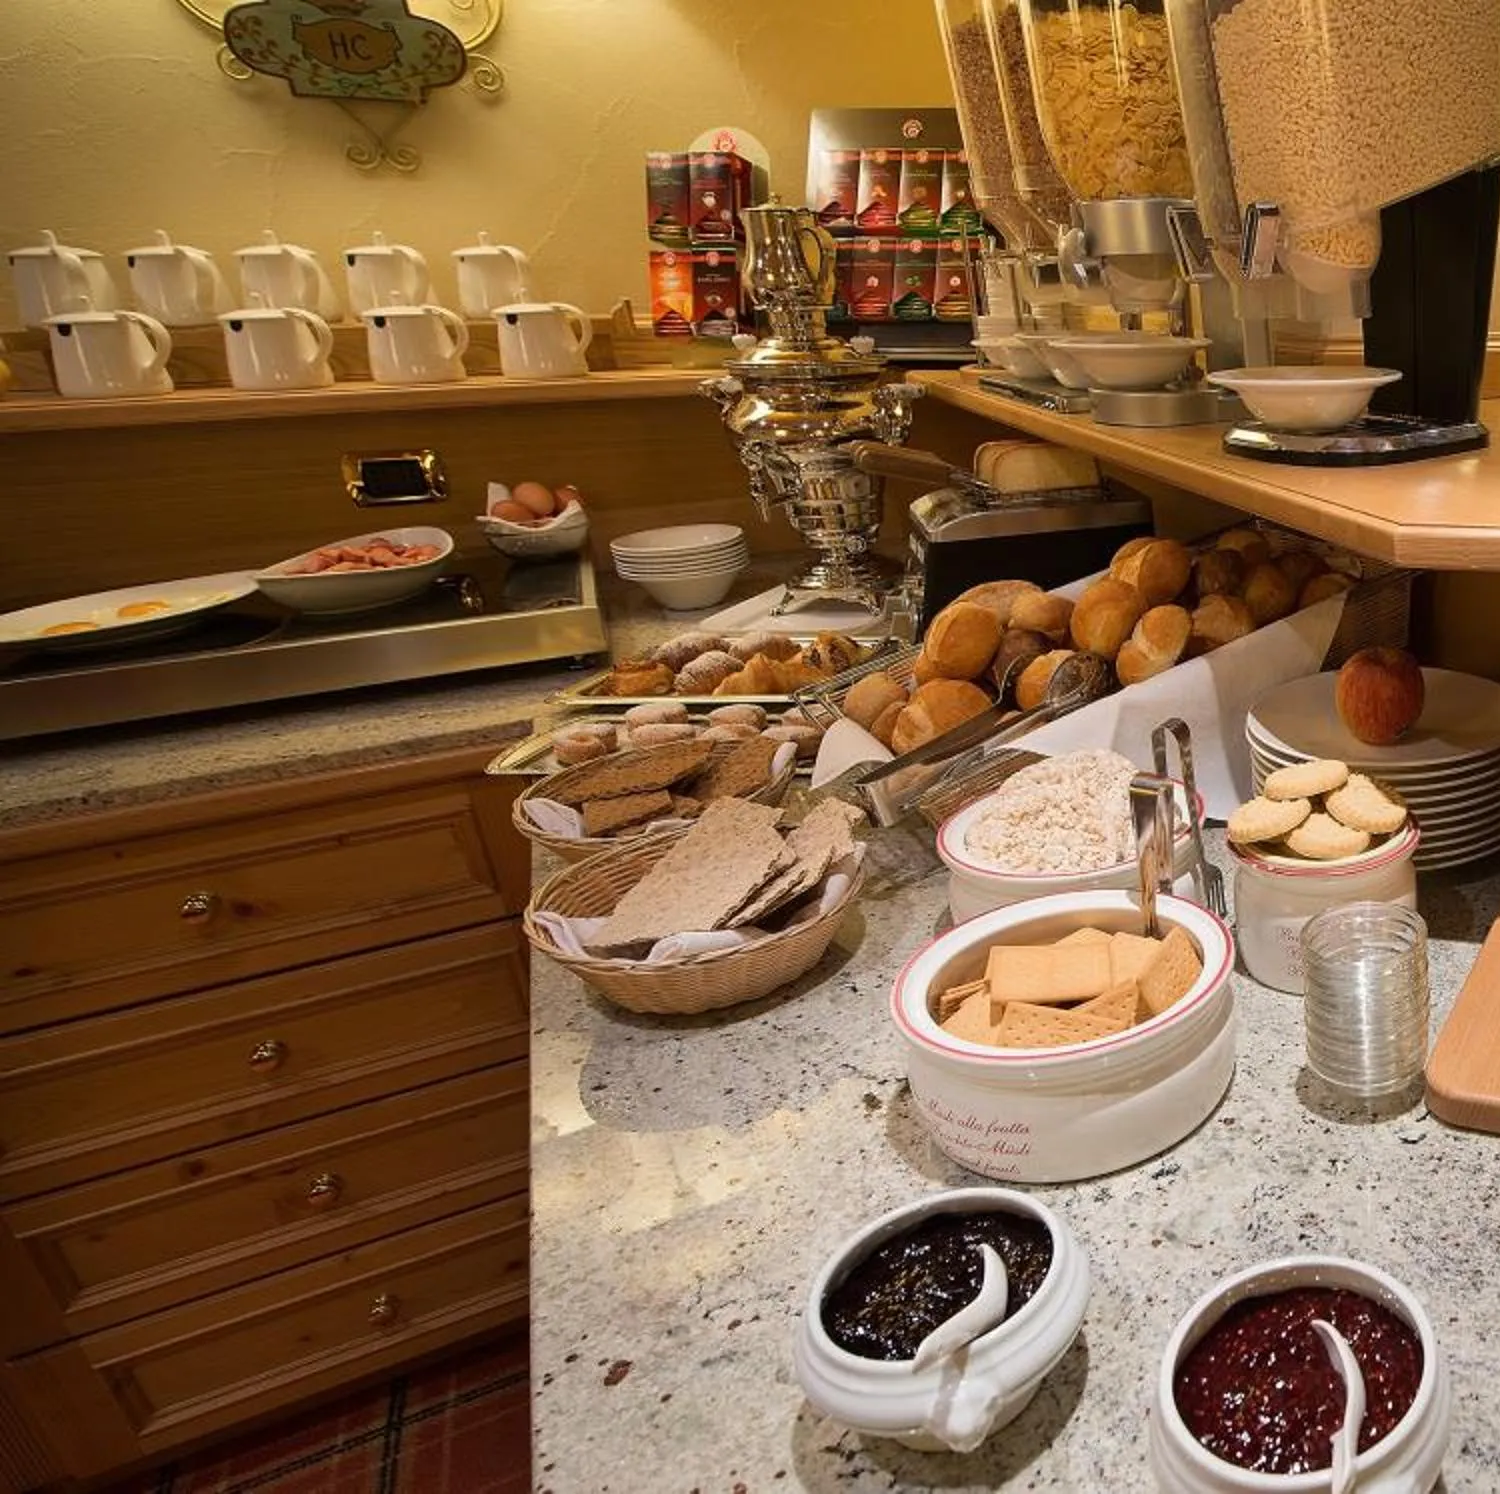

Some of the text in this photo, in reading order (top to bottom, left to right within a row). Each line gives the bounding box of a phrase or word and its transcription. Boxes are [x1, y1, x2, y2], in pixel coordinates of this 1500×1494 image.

[327, 31, 372, 61] HC
[957, 1115, 982, 1131] alla
[985, 1119, 1029, 1136] frutta
